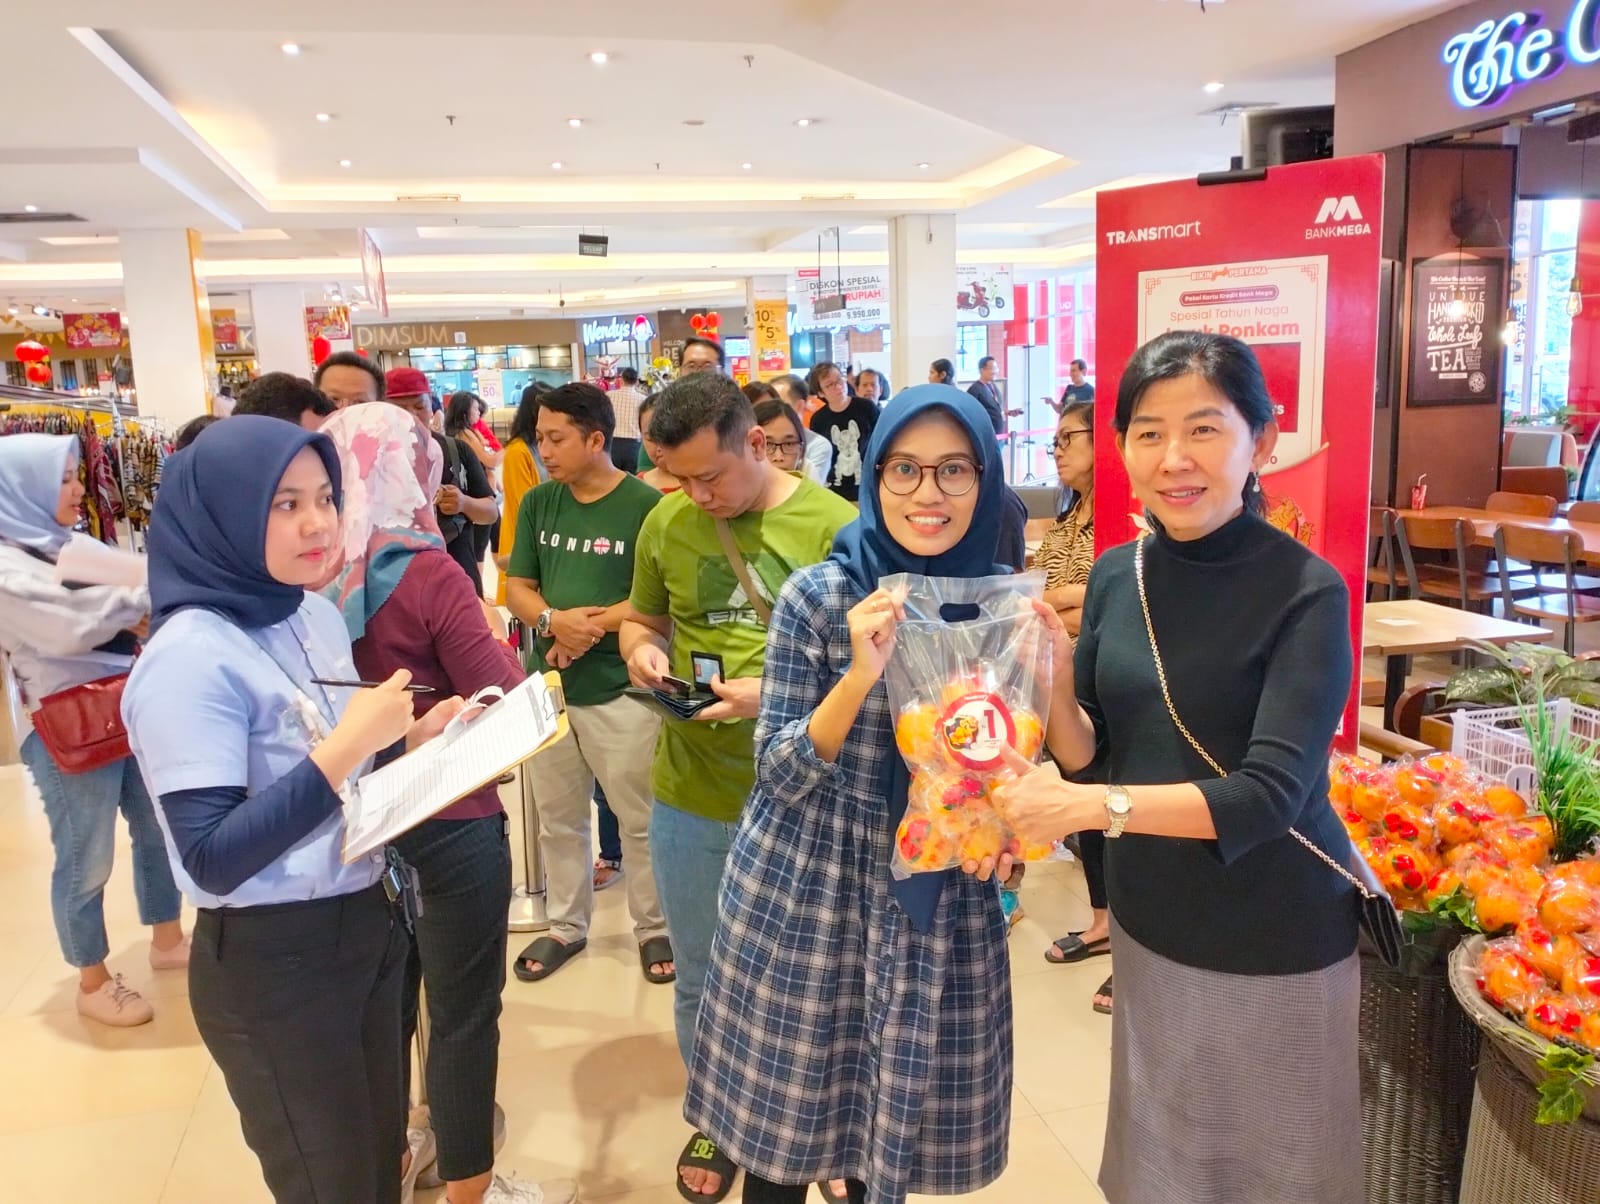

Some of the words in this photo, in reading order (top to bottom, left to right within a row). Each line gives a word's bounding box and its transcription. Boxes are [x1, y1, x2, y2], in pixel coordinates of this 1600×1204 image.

[1443, 11, 1553, 108] The
[847, 275, 881, 287] SPESIAL
[845, 289, 881, 302] RUPIAH
[1170, 309, 1212, 322] Spesial
[1215, 307, 1251, 319] Tahun
[1255, 305, 1289, 317] Naga
[357, 325, 449, 347] DIMSUM
[1428, 325, 1456, 342] Whole
[1426, 348, 1467, 372] TEA
